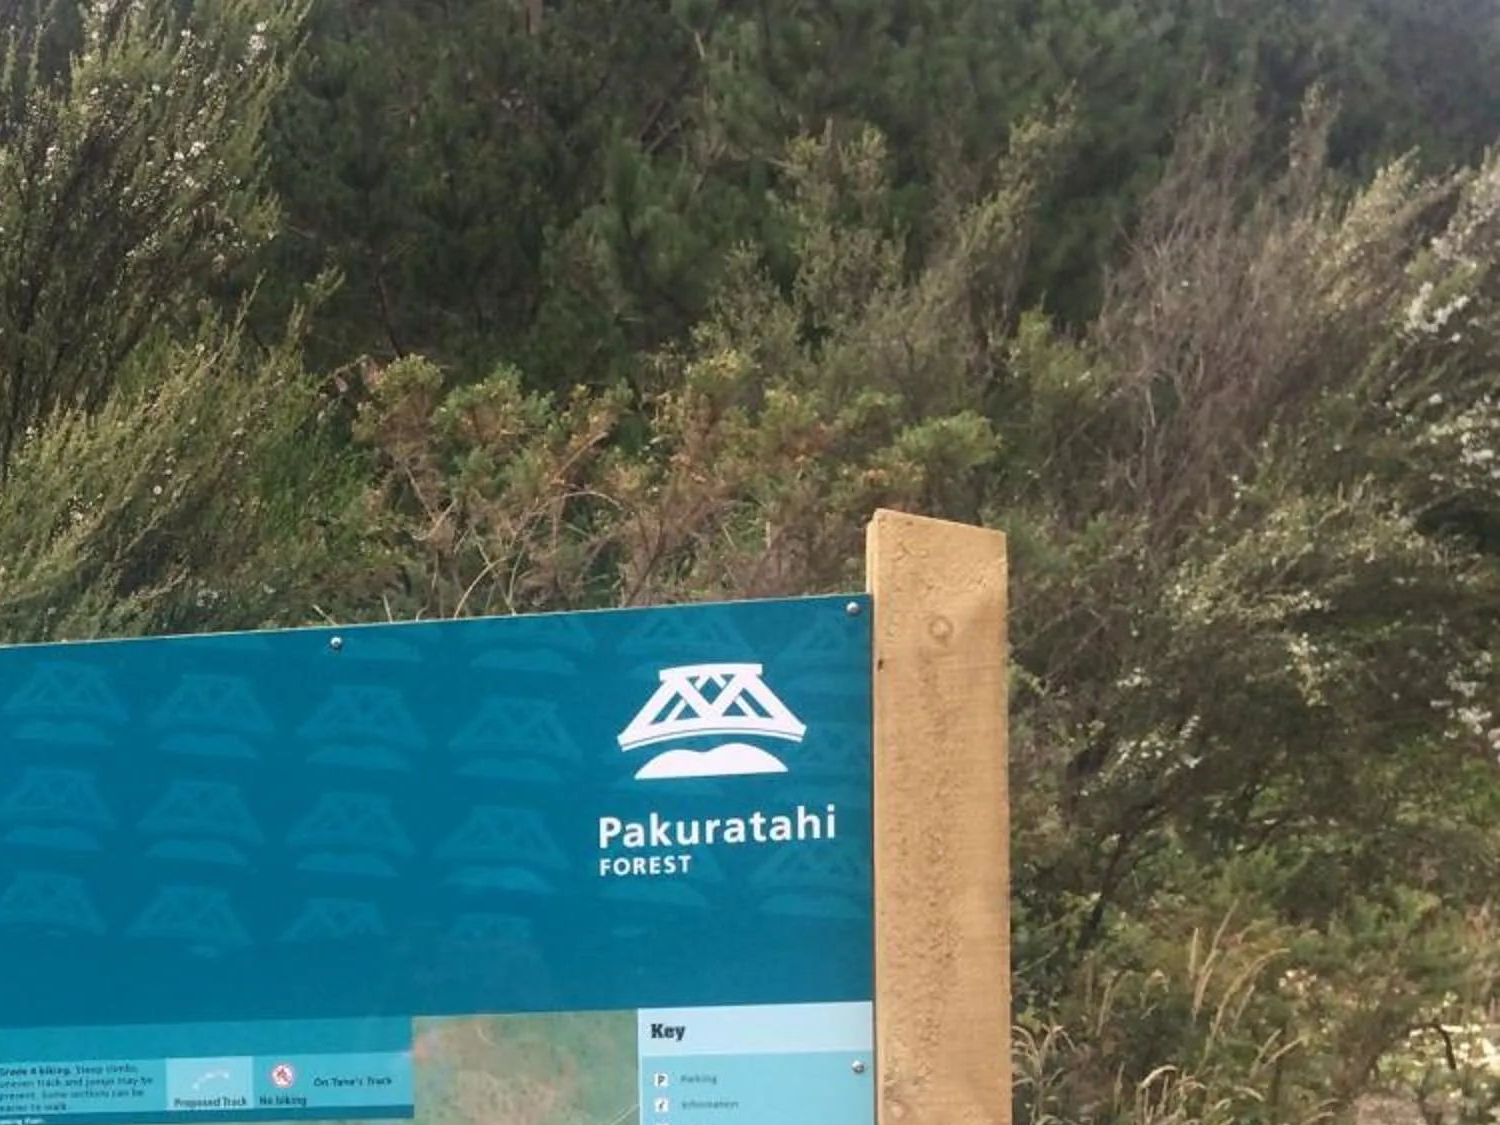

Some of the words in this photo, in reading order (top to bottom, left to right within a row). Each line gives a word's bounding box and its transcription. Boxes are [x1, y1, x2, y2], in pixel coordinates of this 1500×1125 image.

[600, 804, 836, 848] Pakuratahi
[600, 855, 691, 876] FOREST
[651, 1023, 686, 1042] Key
[313, 1077, 329, 1087] On
[223, 1096, 247, 1106] Track
